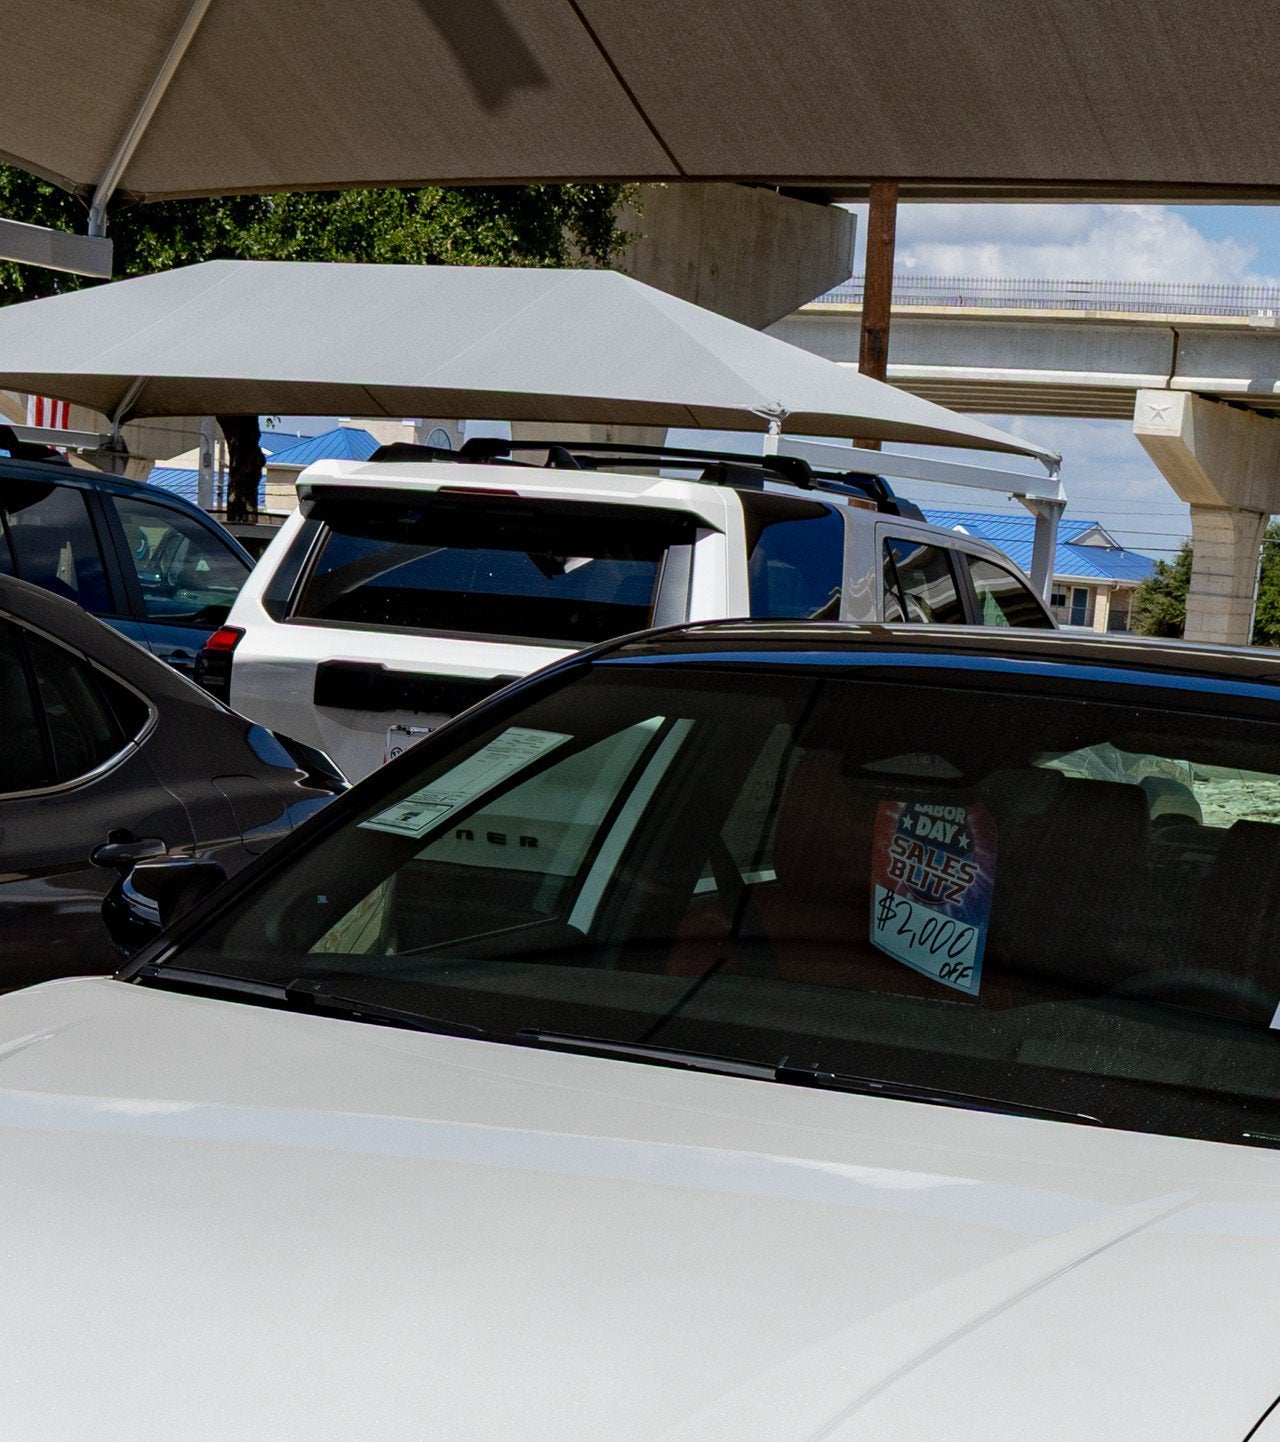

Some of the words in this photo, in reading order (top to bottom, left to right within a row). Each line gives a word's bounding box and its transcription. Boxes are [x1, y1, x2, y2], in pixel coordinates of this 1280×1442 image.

[915, 815, 959, 844] DAY
[888, 857, 967, 905] BLITZ
[890, 835, 978, 885] SALES
[877, 890, 975, 959] $2,000
